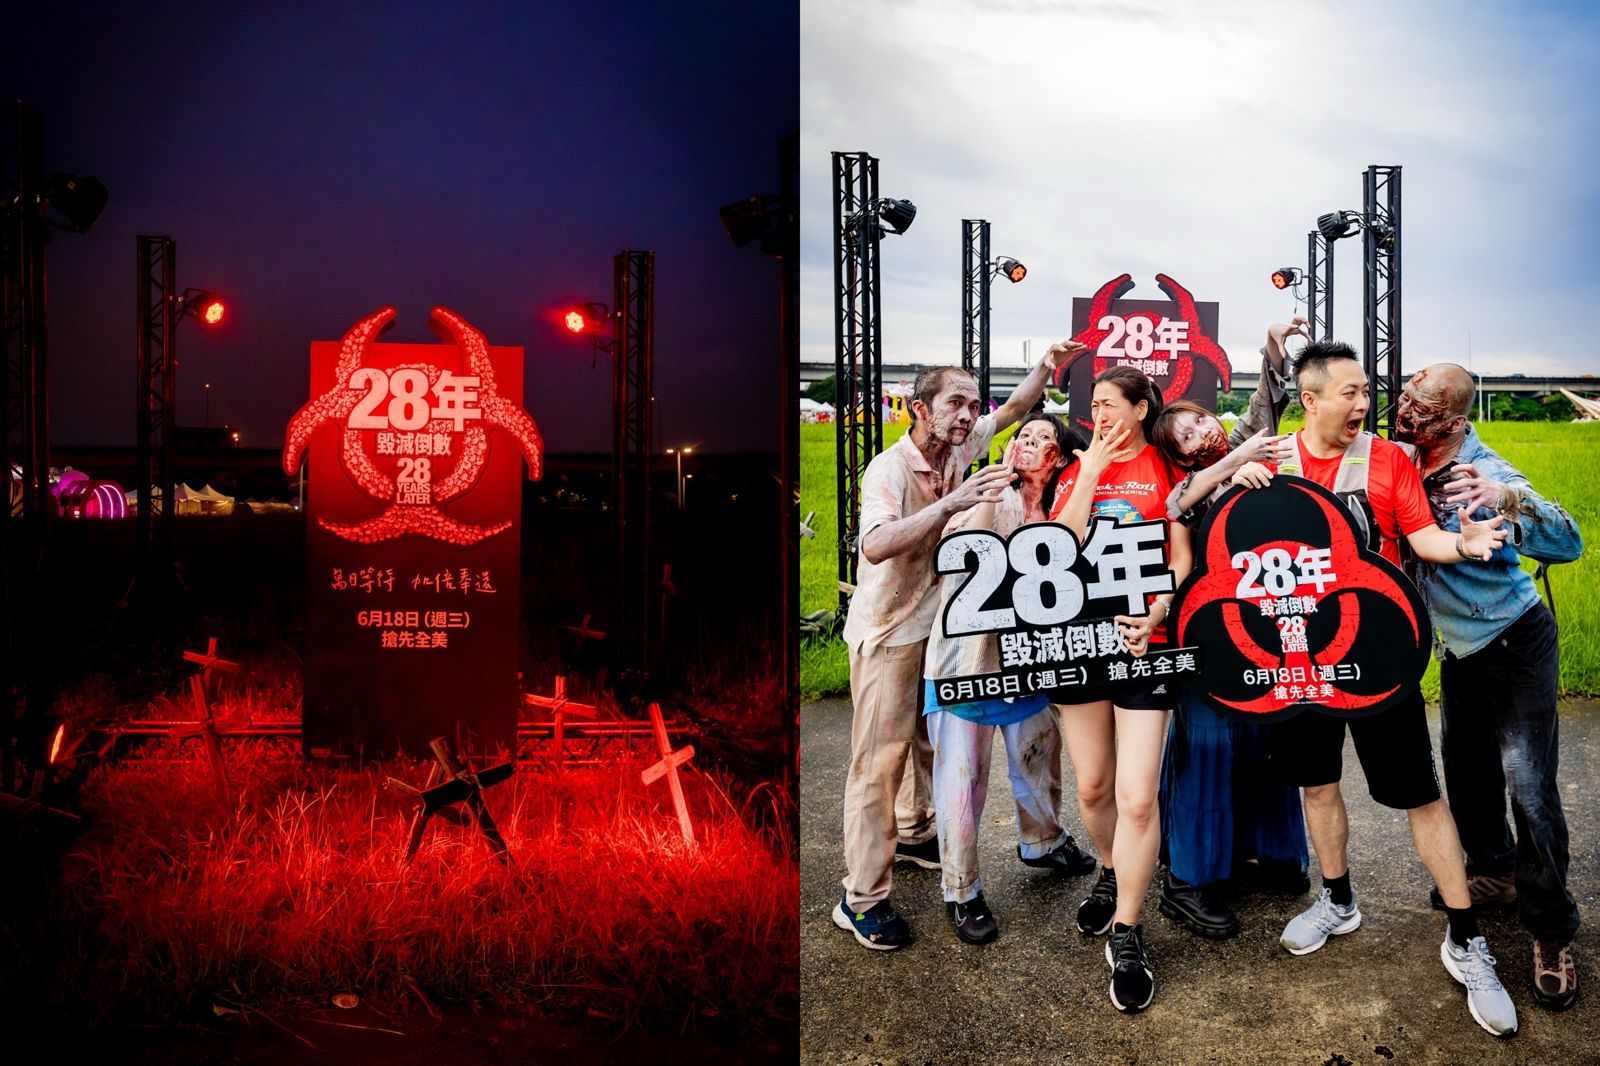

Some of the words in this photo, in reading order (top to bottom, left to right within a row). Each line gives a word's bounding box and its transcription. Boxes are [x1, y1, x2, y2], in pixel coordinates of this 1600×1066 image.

[1097, 315, 1190, 360] 28年
[348, 367, 481, 433] 28年
[376, 432, 452, 456] 毀滅倒數
[396, 457, 431, 484] 28
[396, 482, 431, 493] YEARS
[396, 492, 431, 504] LATER
[937, 519, 1173, 635] 28年
[1231, 545, 1337, 599] 28年
[1260, 595, 1318, 617] 毀滅倒數
[1277, 615, 1306, 637] 28
[381, 631, 448, 648] 搶先全美
[1280, 634, 1308, 645] YEARS
[1281, 643, 1309, 653] LATER
[1108, 653, 1196, 681] 搶先全美
[1274, 683, 1335, 700] 搶先全美
